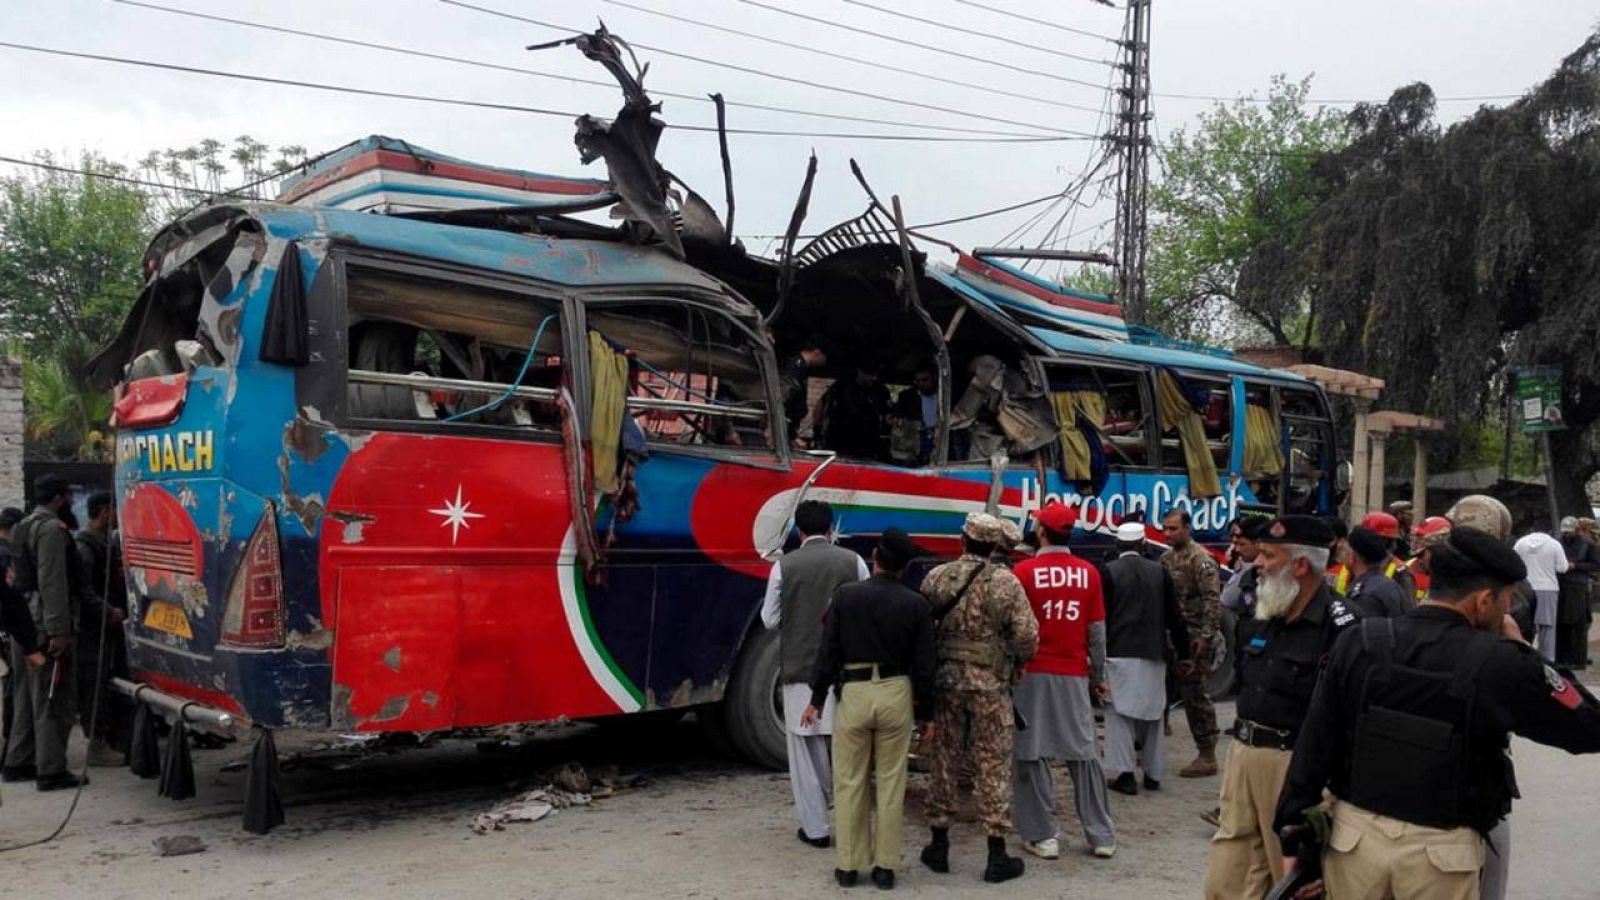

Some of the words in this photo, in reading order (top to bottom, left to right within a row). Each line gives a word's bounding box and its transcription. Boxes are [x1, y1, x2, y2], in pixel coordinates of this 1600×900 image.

[1020, 477, 1147, 536] Hroon
[1033, 566, 1089, 589] EDHI
[1042, 600, 1080, 621] 115
